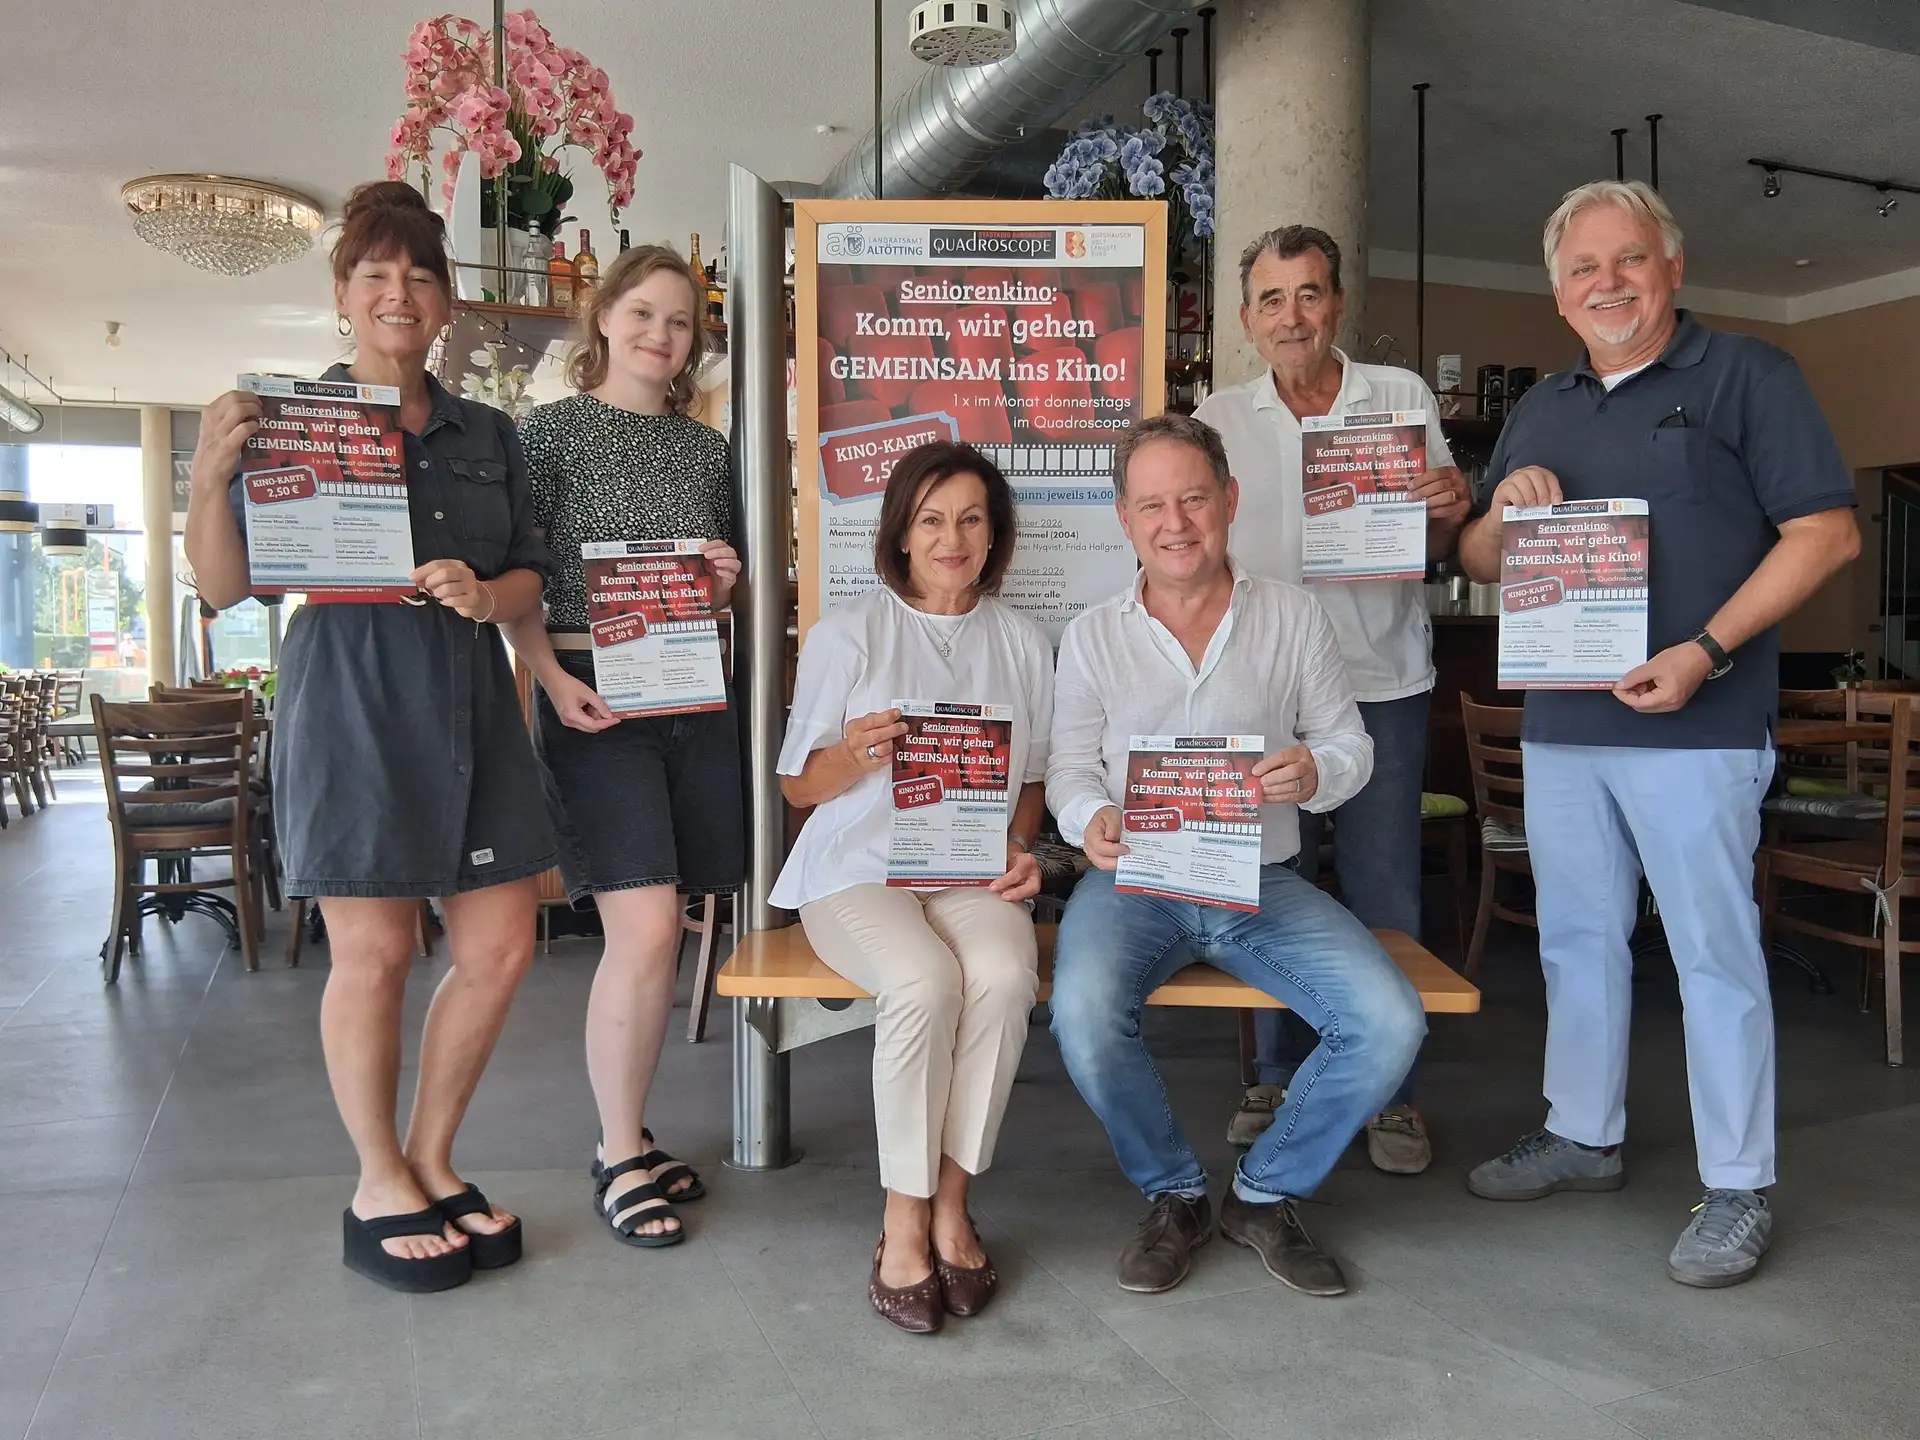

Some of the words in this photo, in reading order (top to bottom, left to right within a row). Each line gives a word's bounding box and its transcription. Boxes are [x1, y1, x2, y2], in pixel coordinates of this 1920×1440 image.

[868, 237, 922, 245] LANDRATSAMT
[867, 243, 923, 256] ALTÖTTING
[900, 280, 1058, 304] Seniorenkino:
[856, 312, 951, 341] Komm,
[958, 314, 1006, 337] wir
[1012, 313, 1096, 343] gehen
[830, 356, 1002, 381] GEMEINSAM
[1008, 357, 1049, 381] ins
[1056, 358, 1127, 382] Kino!
[953, 394, 958, 407] 1
[962, 398, 970, 407] x
[974, 395, 991, 407] im
[994, 394, 1040, 408] Monat
[1044, 395, 1131, 411] donnerstags
[280, 403, 360, 419] Seniorenkino:
[258, 418, 308, 434] Komm,
[312, 421, 336, 433] wir
[339, 423, 380, 436] gehen
[1013, 417, 1030, 429] im
[1033, 415, 1130, 433] Quadroscope
[1333, 433, 1394, 444] Seniorenkino:
[247, 437, 335, 453] GEMEINSAM
[338, 443, 359, 454] ins
[361, 444, 397, 456] Kino!
[835, 430, 937, 462] KINO-KARTE
[1316, 448, 1353, 458] Komm,
[1355, 445, 1375, 455] wir
[1376, 444, 1409, 456] gehen
[1307, 461, 1372, 474] GEMEINSAM
[1374, 460, 1391, 470] ins
[1393, 459, 1421, 469] Kino!
[252, 474, 306, 488] KINO-KARTE
[267, 486, 290, 498] 2,50
[1012, 490, 1044, 502] eginn:
[1046, 490, 1084, 502] jeweils
[1087, 490, 1114, 500] 14.00
[1308, 489, 1349, 503] KINO-KARTE
[1318, 501, 1336, 511] 2,50
[829, 517, 839, 525] 10.
[842, 517, 880, 527] Septemb
[1041, 519, 1062, 527] 2026
[1538, 522, 1609, 534] Seniorenkino:
[829, 529, 866, 537] Mamma
[1016, 531, 1048, 539] Himmel
[1051, 530, 1079, 541] (2004)
[844, 542, 866, 550] Meryl
[1033, 543, 1064, 552] Nyqvist,
[1066, 543, 1087, 551] Frida
[1089, 543, 1124, 552] Hallgren
[1518, 538, 1561, 548] Komm,
[1563, 535, 1586, 546] wir
[1588, 535, 1627, 547] gehen
[1506, 554, 1584, 566] GEMEINSAM
[1586, 552, 1606, 563] ins
[1608, 551, 1641, 562] Kino!
[616, 561, 678, 572] Seniorenkino:
[829, 565, 839, 573] 01.
[842, 565, 876, 573] Oktobe
[600, 575, 639, 586] Komm,
[641, 572, 660, 583] wir
[662, 572, 694, 585] gehen
[829, 577, 848, 585] Ach,
[1012, 579, 1066, 588] Sektempfang
[592, 590, 660, 603] GEMEINSAM
[662, 588, 679, 598] ins
[680, 587, 707, 598] Kino!
[1044, 590, 1061, 598] alle
[1508, 583, 1554, 599] KINO-KARTE
[1519, 596, 1538, 607] 2,50
[597, 618, 639, 635] KINO-KARTE
[608, 630, 627, 642] 2,50
[922, 722, 981, 734] Seniorenkino:
[905, 734, 941, 747] Komm,
[943, 736, 961, 747] wir
[963, 737, 994, 749] gehen
[896, 752, 959, 764] GEMEINSAM
[961, 754, 976, 764] ins
[978, 755, 1005, 766] Kino!
[1161, 757, 1227, 766] Seniorenkino:
[1142, 768, 1182, 780] Komm,
[1184, 769, 1205, 780] wir
[1207, 770, 1243, 782] gehen
[898, 783, 936, 795] KINO-KARTE
[1130, 785, 1203, 796] GEMEINSAM
[1205, 787, 1223, 797] ins
[1226, 788, 1256, 798] Kino!
[908, 794, 924, 804] 2,50
[1130, 813, 1175, 821] KINO-KARTE
